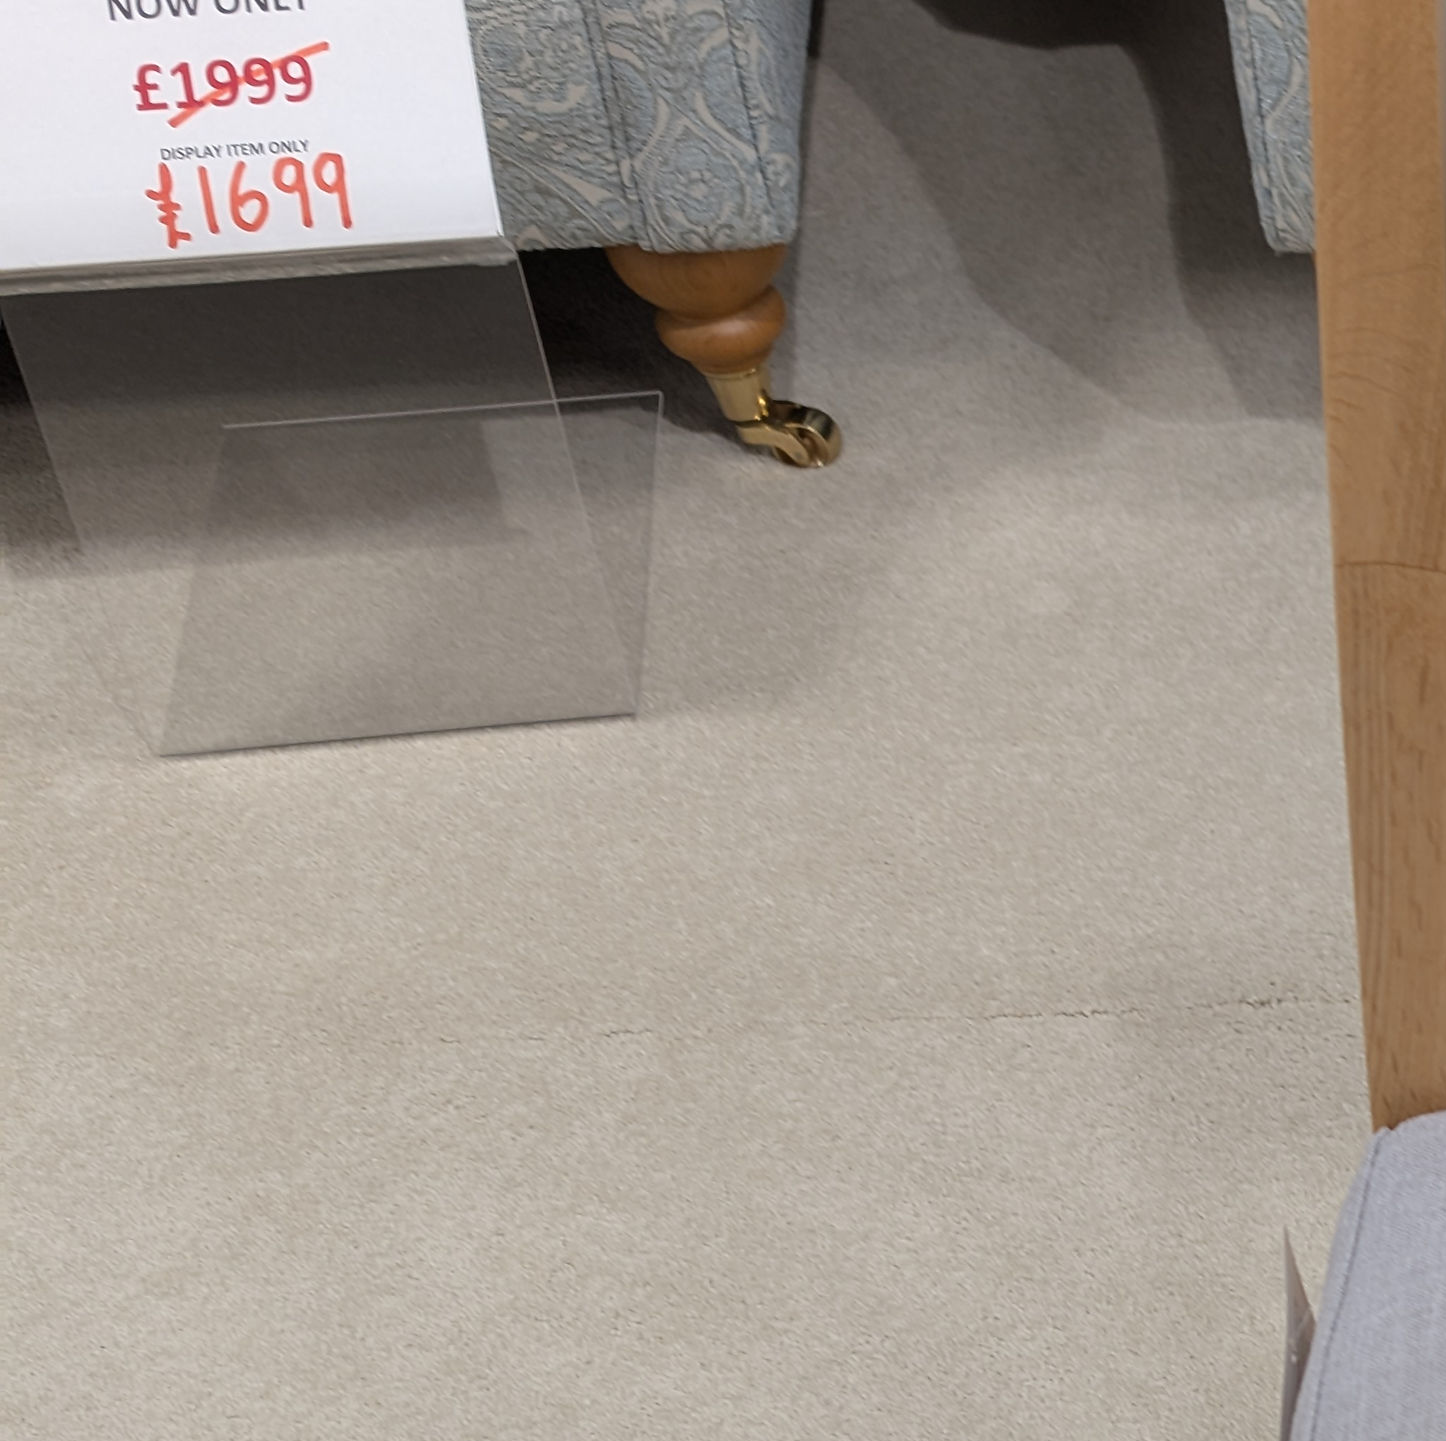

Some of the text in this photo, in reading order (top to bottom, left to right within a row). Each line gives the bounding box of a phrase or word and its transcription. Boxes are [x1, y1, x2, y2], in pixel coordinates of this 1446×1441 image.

[133, 55, 313, 111] £1999
[160, 140, 309, 161] DISPLAY ITEM ONLY
[145, 152, 352, 249] £1699
